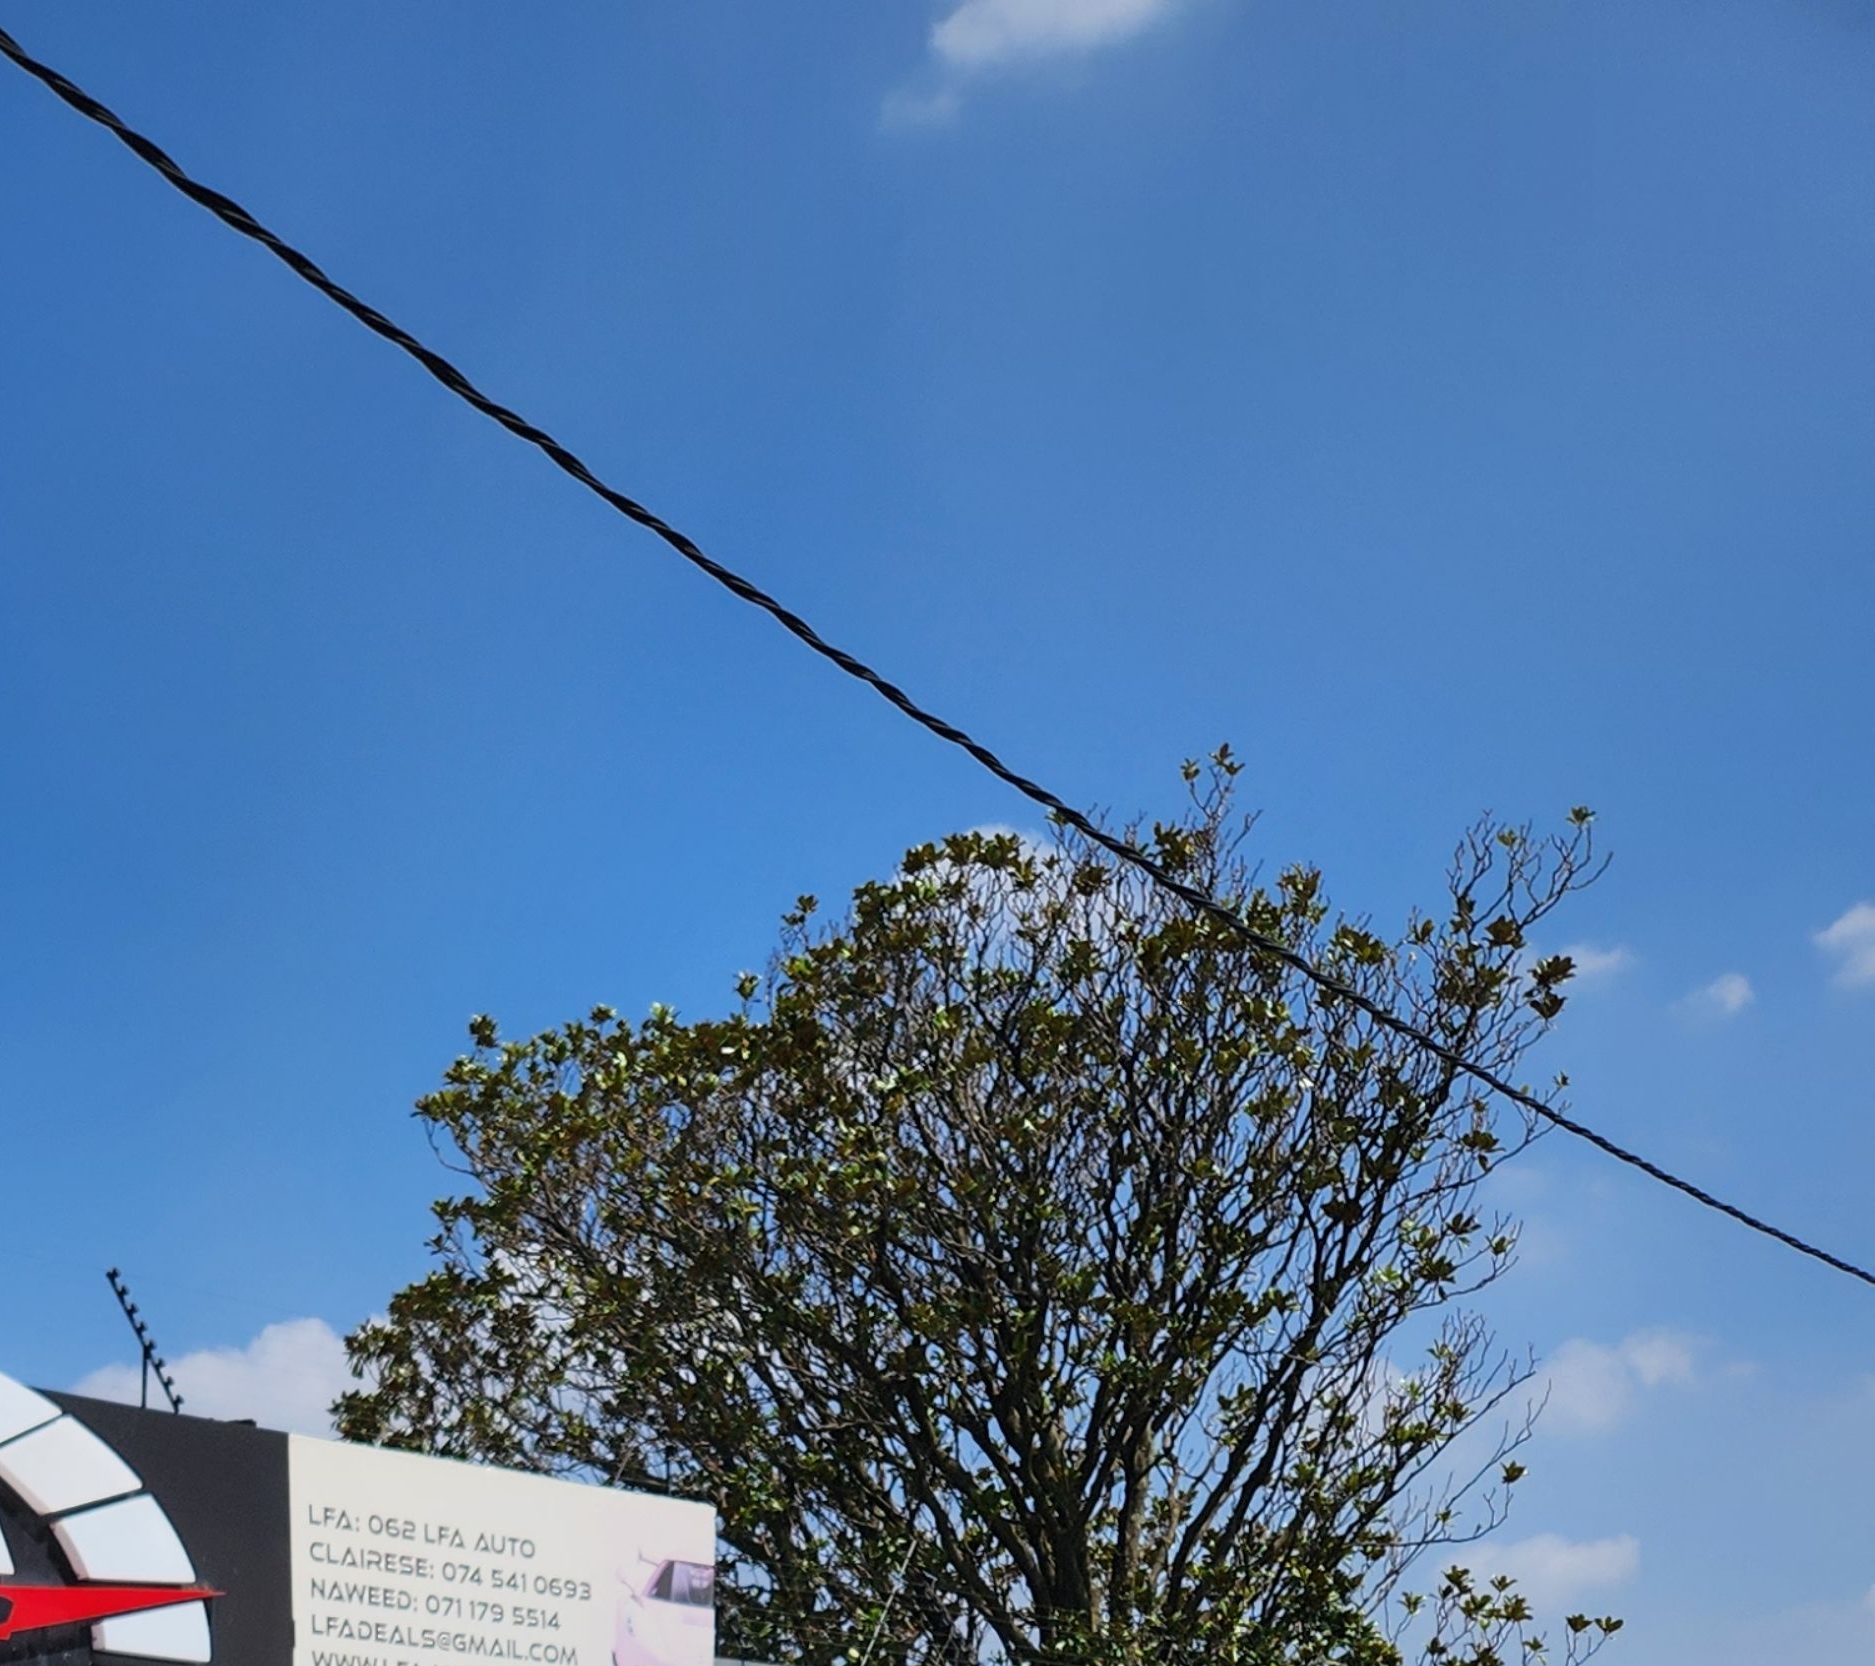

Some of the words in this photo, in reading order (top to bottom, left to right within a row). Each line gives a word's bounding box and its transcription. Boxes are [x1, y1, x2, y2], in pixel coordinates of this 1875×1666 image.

[308, 1504, 361, 1532] LFA:
[368, 1514, 416, 1541] 062
[424, 1523, 465, 1549] LFA
[474, 1533, 535, 1559] AUTO
[309, 1542, 435, 1580] CLAIRESE:
[441, 1561, 482, 1585] 074
[490, 1569, 526, 1592] 541
[533, 1575, 592, 1601] 0693
[311, 1578, 418, 1613] NAWEED:
[425, 1594, 462, 1618] 071
[469, 1600, 504, 1624] 179
[512, 1606, 561, 1630] 5514
[312, 1614, 578, 1666] LFADEALS@GMAIL.COM
